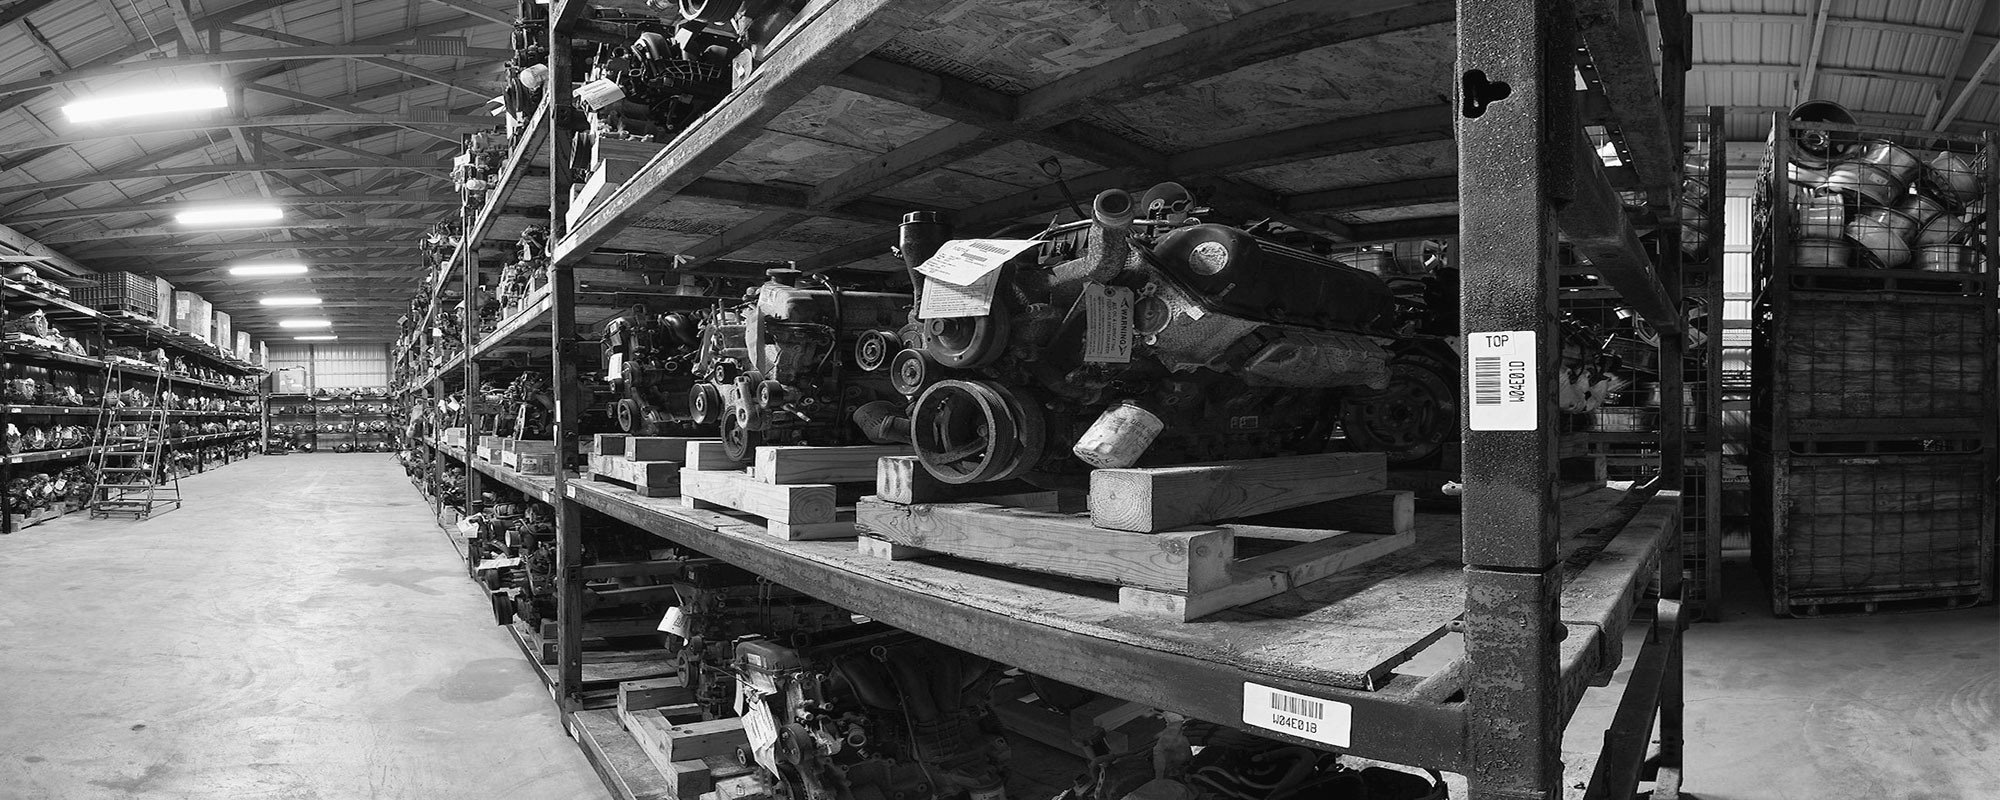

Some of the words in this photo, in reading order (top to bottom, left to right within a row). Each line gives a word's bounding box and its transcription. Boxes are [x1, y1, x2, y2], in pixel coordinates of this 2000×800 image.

[1119, 308, 1128, 346] WARNING
[1486, 335, 1509, 348] TOP
[1508, 361, 1525, 403] W04E01D
